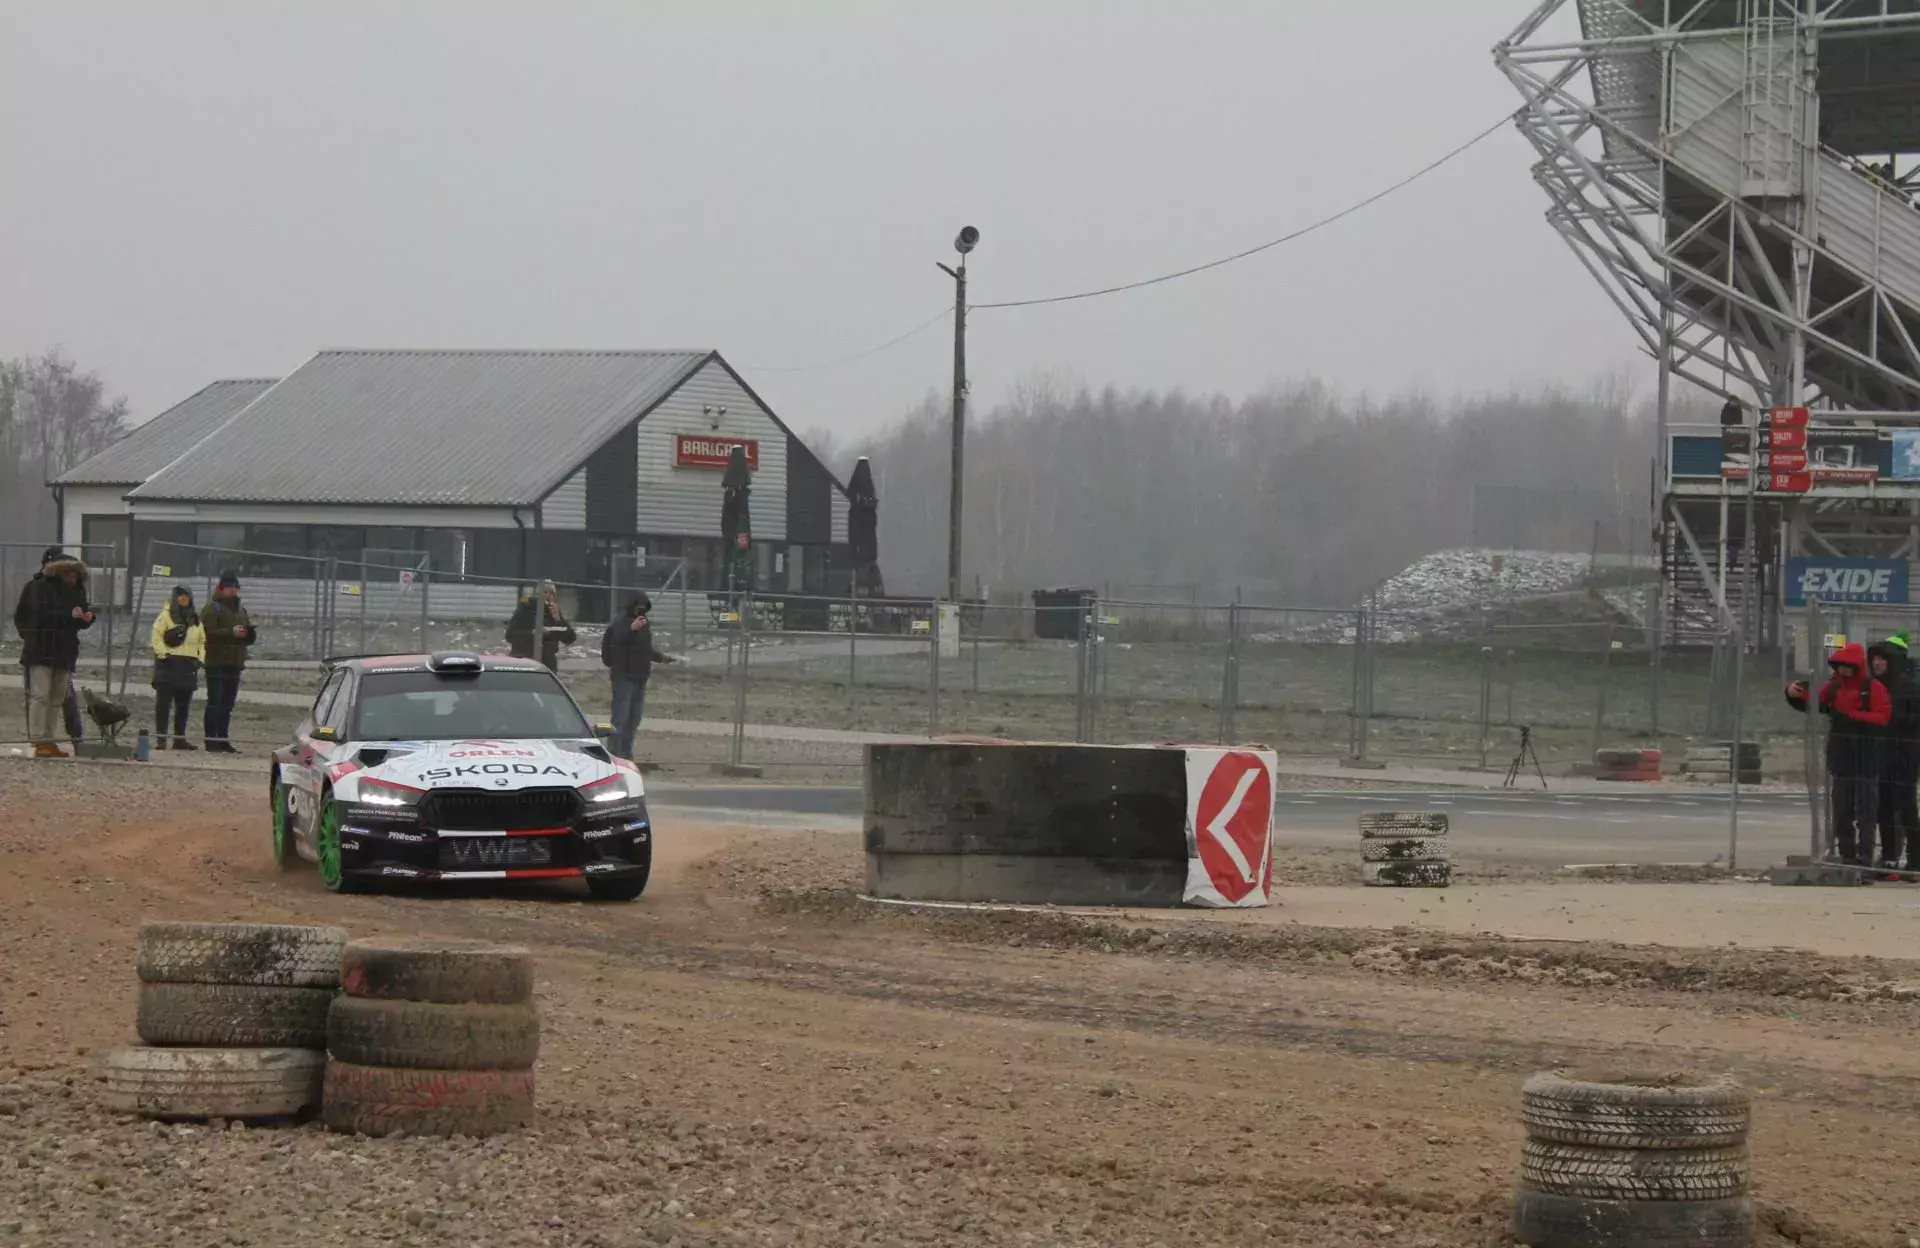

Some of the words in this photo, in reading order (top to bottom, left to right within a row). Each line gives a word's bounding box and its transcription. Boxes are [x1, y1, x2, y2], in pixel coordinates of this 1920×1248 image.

[683, 441, 752, 458] BAR&GRL
[1799, 568, 1892, 594] EXIDE
[449, 749, 535, 758] ORLEN
